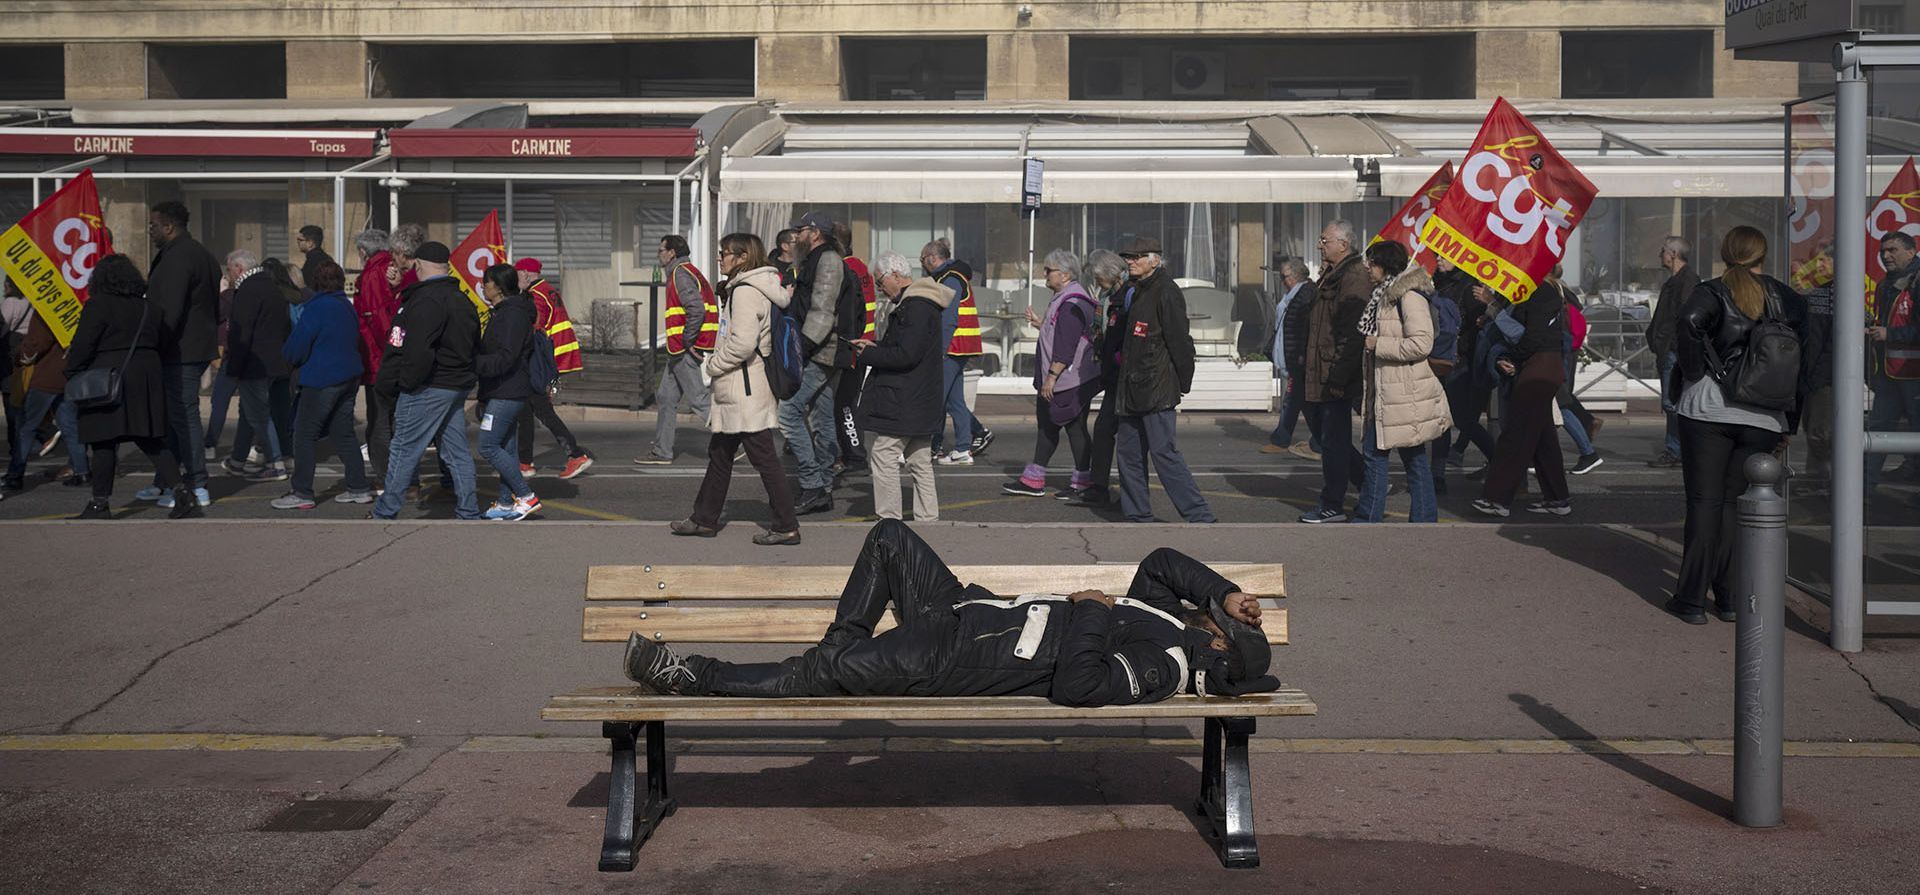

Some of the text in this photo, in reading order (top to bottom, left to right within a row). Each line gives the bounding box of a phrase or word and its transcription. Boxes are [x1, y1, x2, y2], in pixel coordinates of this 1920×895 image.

[1755, 8, 1774, 30] Quai
[1775, 6, 1786, 24] du
[1788, 2, 1808, 22] Port
[74, 137, 346, 155] CARMINE Tapas
[511, 138, 572, 155] CARMINE
[1462, 151, 1573, 258] cgt
[5, 238, 25, 265] UL
[19, 256, 42, 279] du
[32, 268, 63, 305] Pays
[53, 217, 98, 289] cg
[1427, 226, 1528, 303] IMPÔTS
[842, 406, 861, 447] adidas
